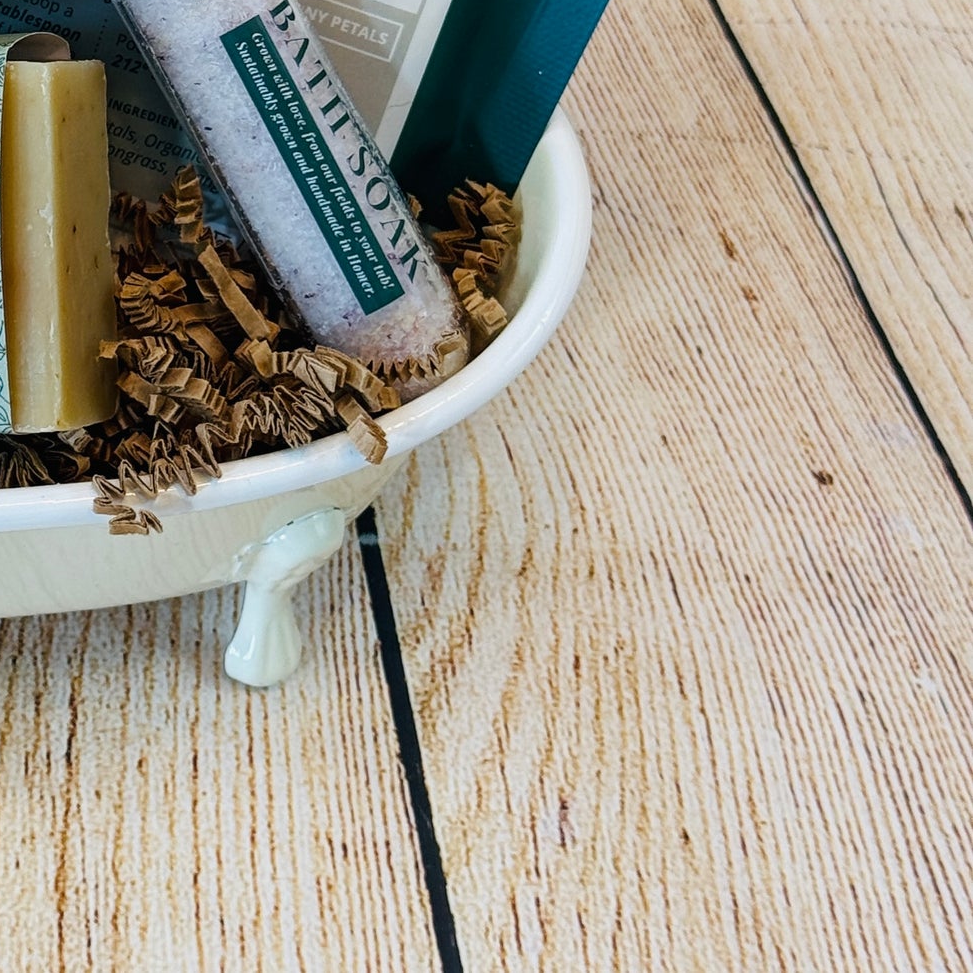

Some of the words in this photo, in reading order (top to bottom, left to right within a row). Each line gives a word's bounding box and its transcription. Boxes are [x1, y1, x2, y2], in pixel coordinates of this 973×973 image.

[63, 6, 75, 18] a
[330, 15, 390, 45] PETALS
[252, 32, 278, 72] Grown
[273, 74, 294, 100] with
[107, 98, 183, 131] INGREDIEN
[107, 122, 137, 145] tals,
[235, 41, 279, 111] Sustainably
[270, 113, 299, 150] grown
[293, 151, 314, 175] and
[306, 176, 345, 238] handmade
[339, 239, 353, 253] in
[301, 132, 324, 161] from
[108, 144, 168, 176] ongrass,
[320, 163, 338, 185] our
[330, 186, 355, 218] fields
[346, 146, 429, 284] SOAK
[350, 221, 363, 234] to
[355, 236, 378, 264] your
[373, 265, 396, 290] tub!
